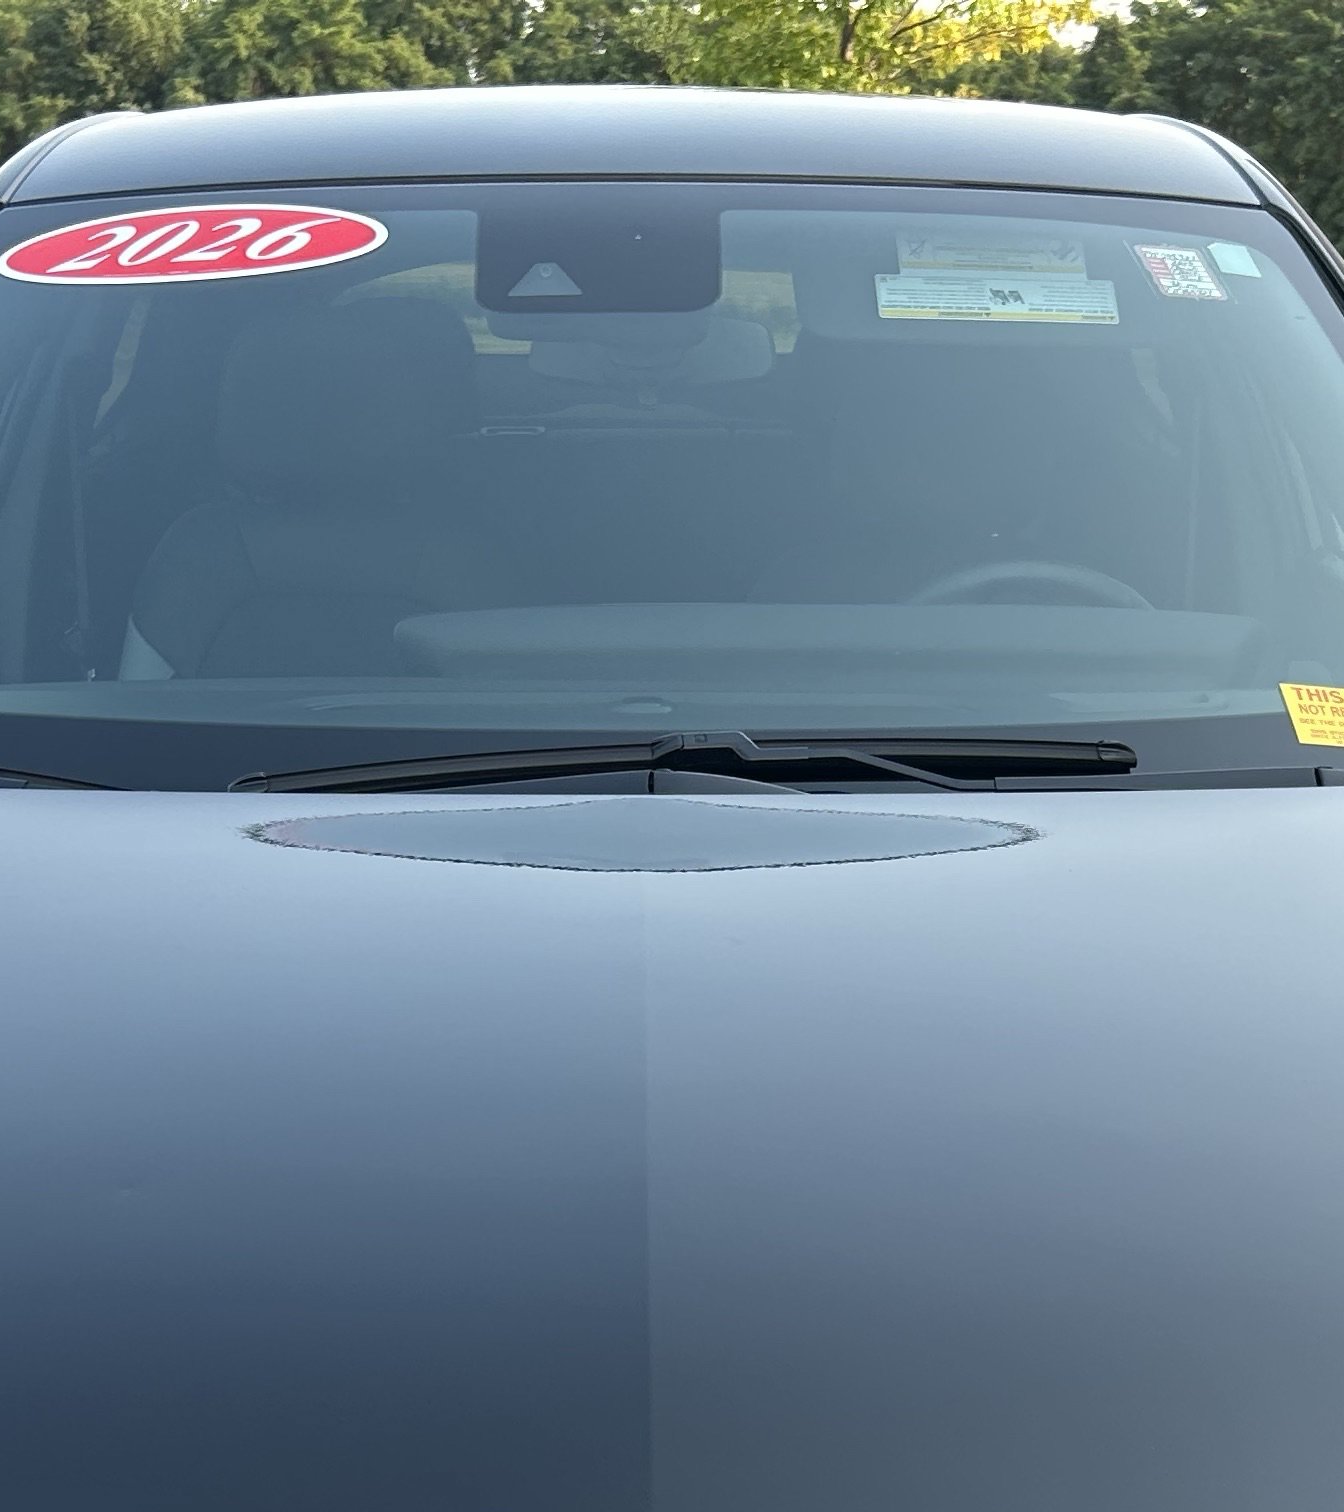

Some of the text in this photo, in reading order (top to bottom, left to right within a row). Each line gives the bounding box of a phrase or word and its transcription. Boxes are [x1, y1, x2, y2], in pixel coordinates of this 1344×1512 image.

[46, 217, 342, 274] 2026
[1291, 687, 1344, 704] THIS
[1298, 703, 1326, 716] NOT
